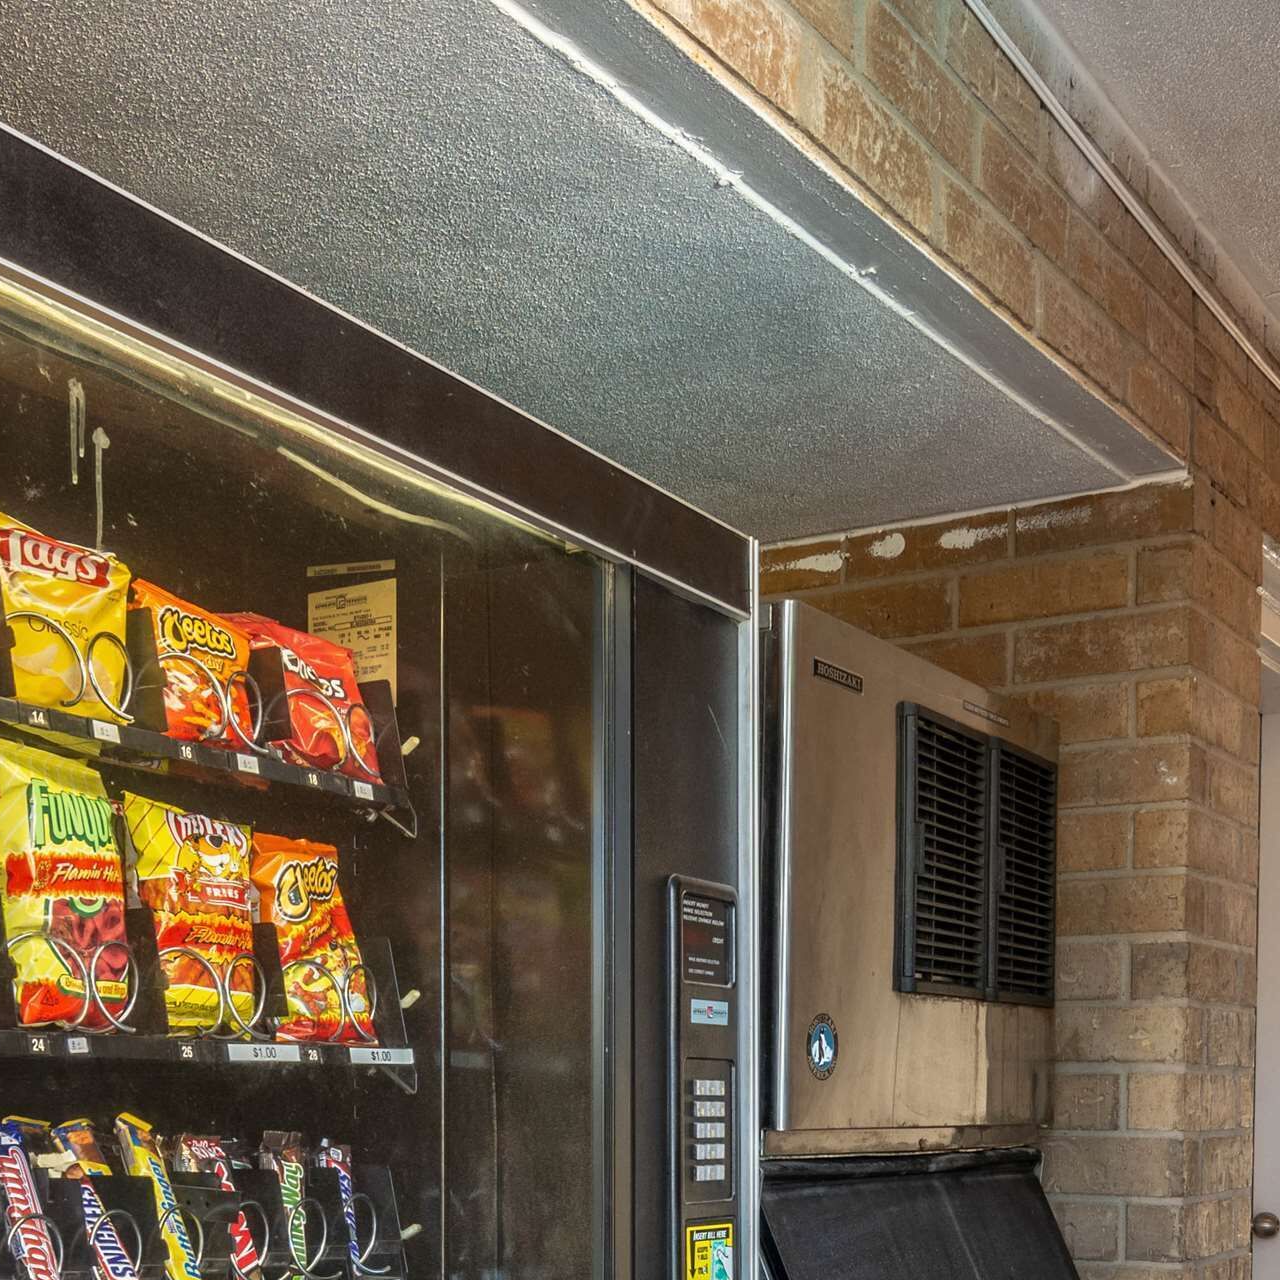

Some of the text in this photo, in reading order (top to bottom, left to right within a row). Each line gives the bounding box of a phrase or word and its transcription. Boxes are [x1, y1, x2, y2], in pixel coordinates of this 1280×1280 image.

[160, 607, 235, 656] Cheetos
[817, 662, 861, 690] HOSHIZAKI
[32, 711, 45, 724] 14
[180, 745, 192, 760] 16
[308, 774, 318, 786] 18
[205, 886, 240, 899] FRIES
[277, 857, 338, 918] Cheetos
[32, 1038, 45, 1052] 24
[181, 1046, 193, 1058] 26
[252, 1048, 277, 1059] $1.00
[308, 1050, 318, 1061] 28
[370, 1051, 392, 1062] $1.00
